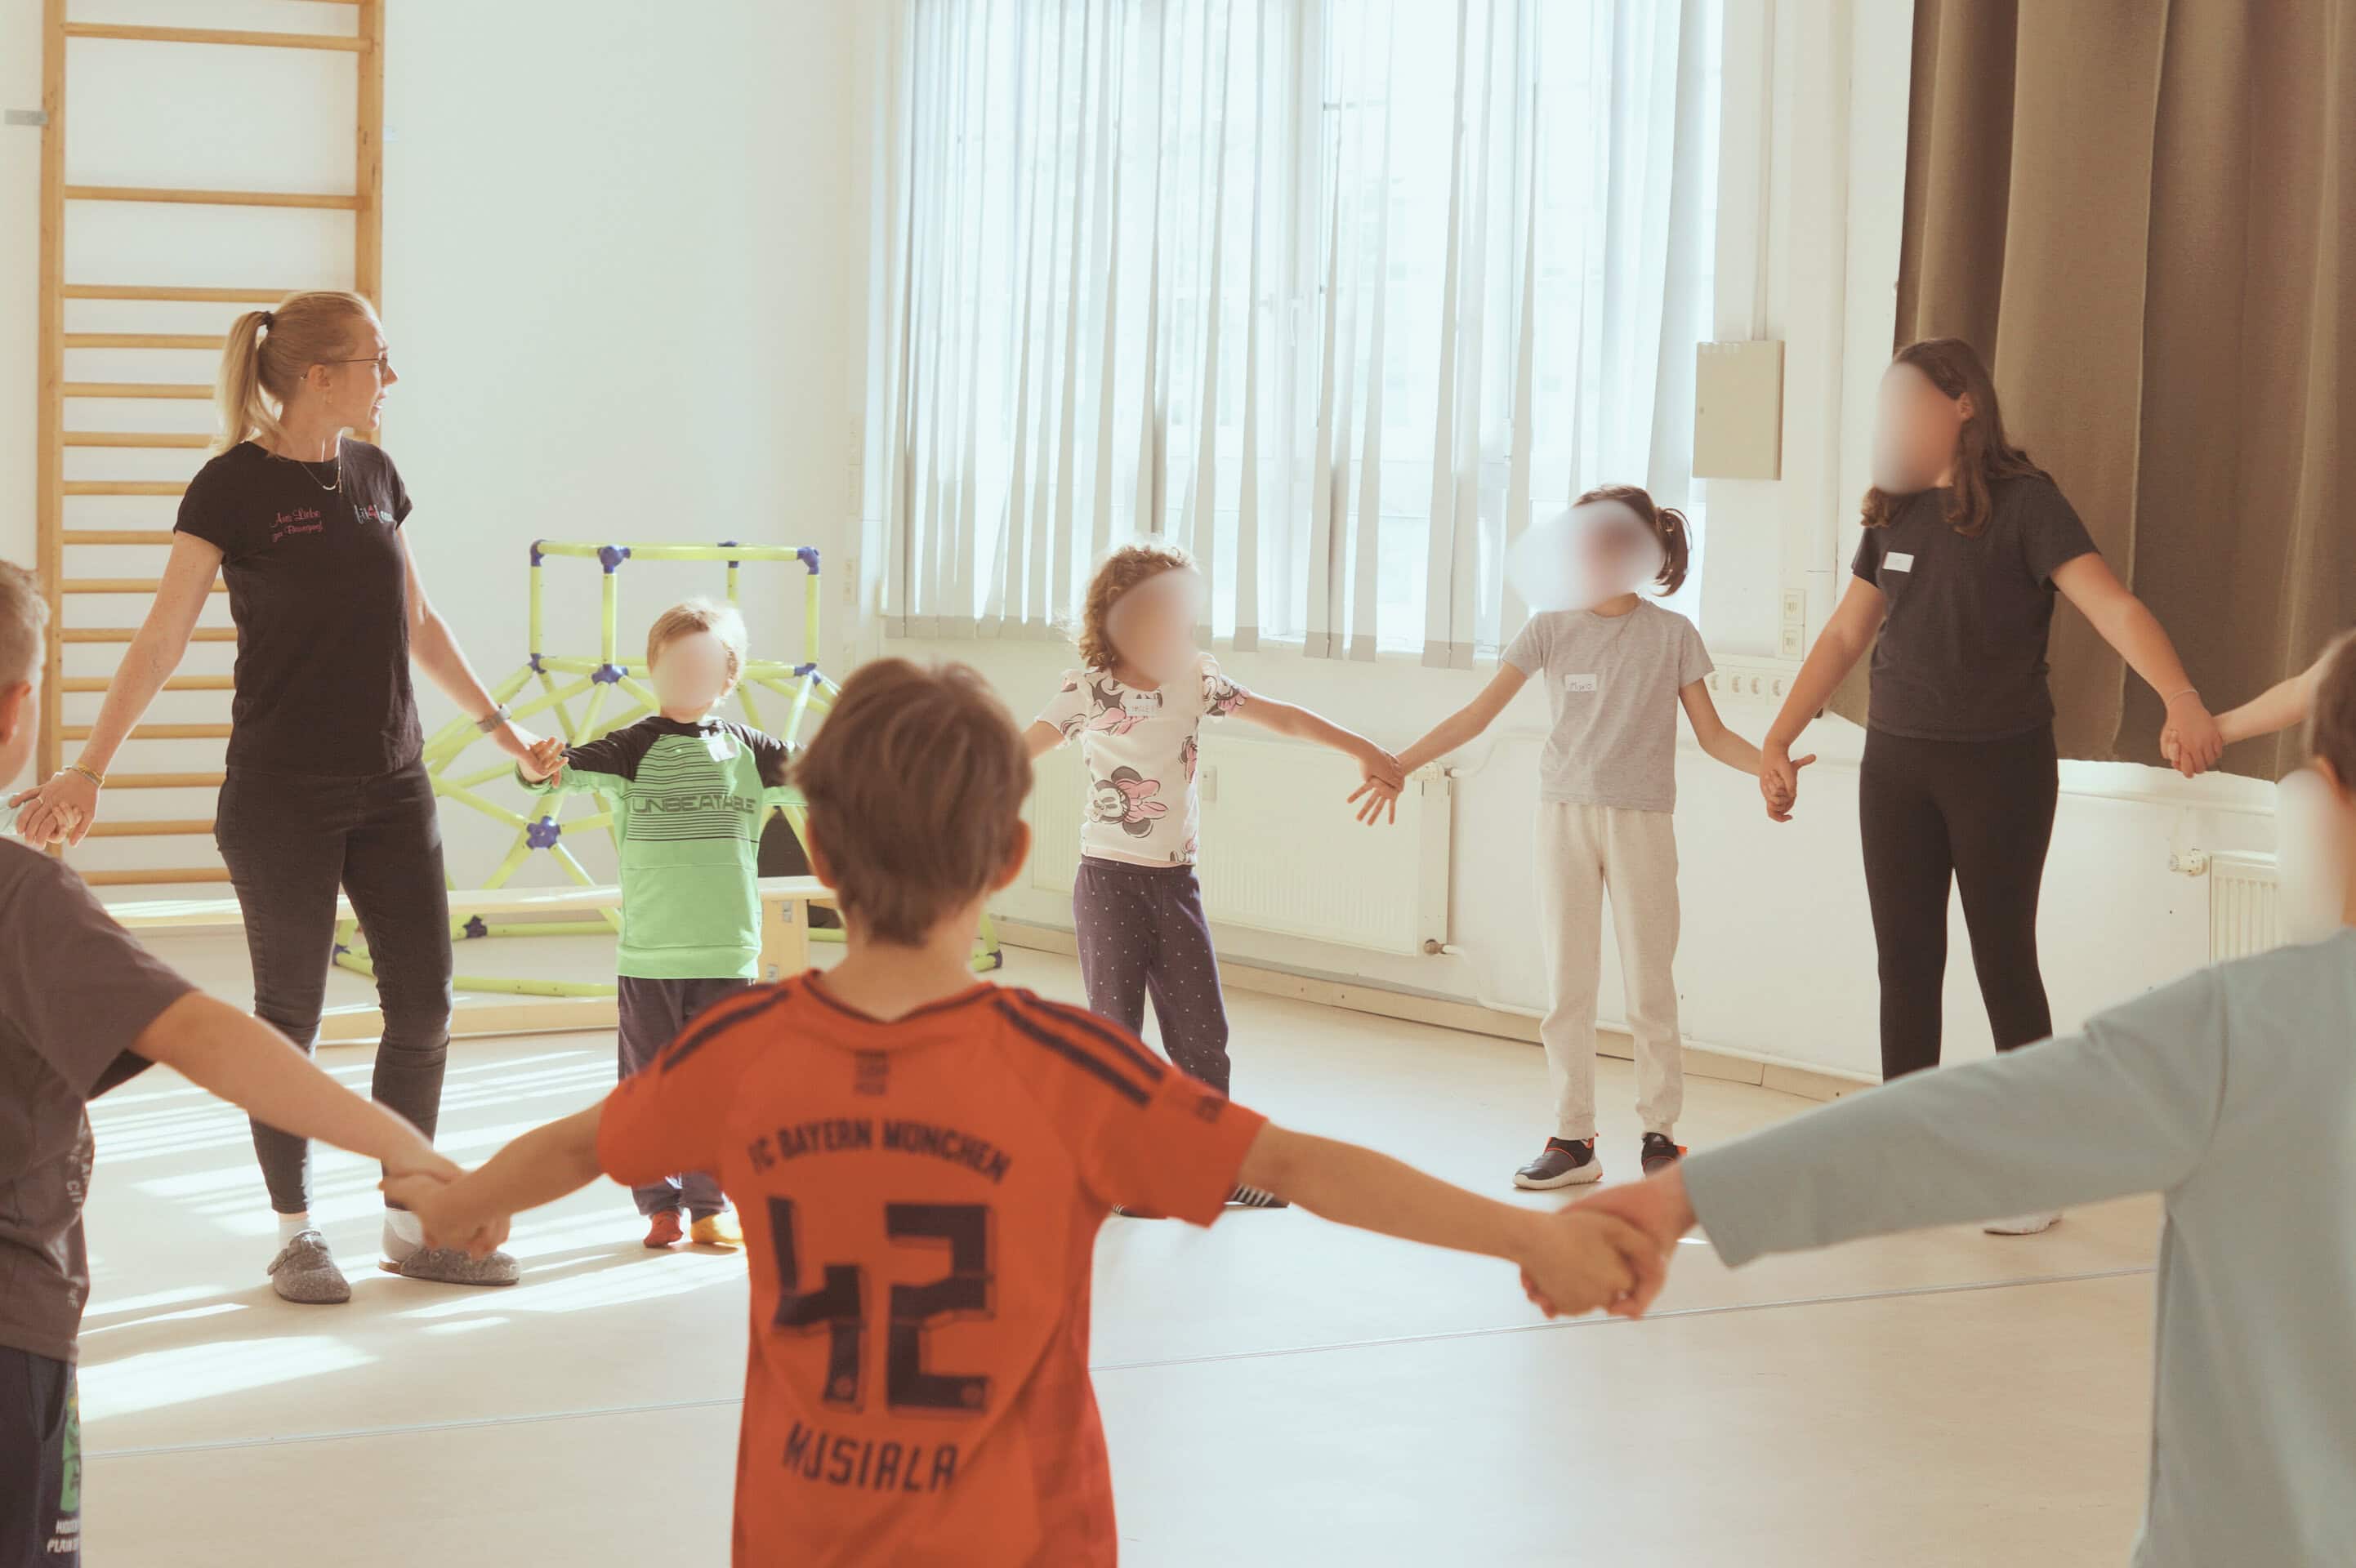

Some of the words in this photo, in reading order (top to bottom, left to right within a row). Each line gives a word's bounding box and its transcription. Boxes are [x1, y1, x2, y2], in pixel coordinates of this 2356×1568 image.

[747, 1136, 775, 1174] FC
[777, 1120, 873, 1160] BAYERN
[766, 1195, 993, 1414] 42
